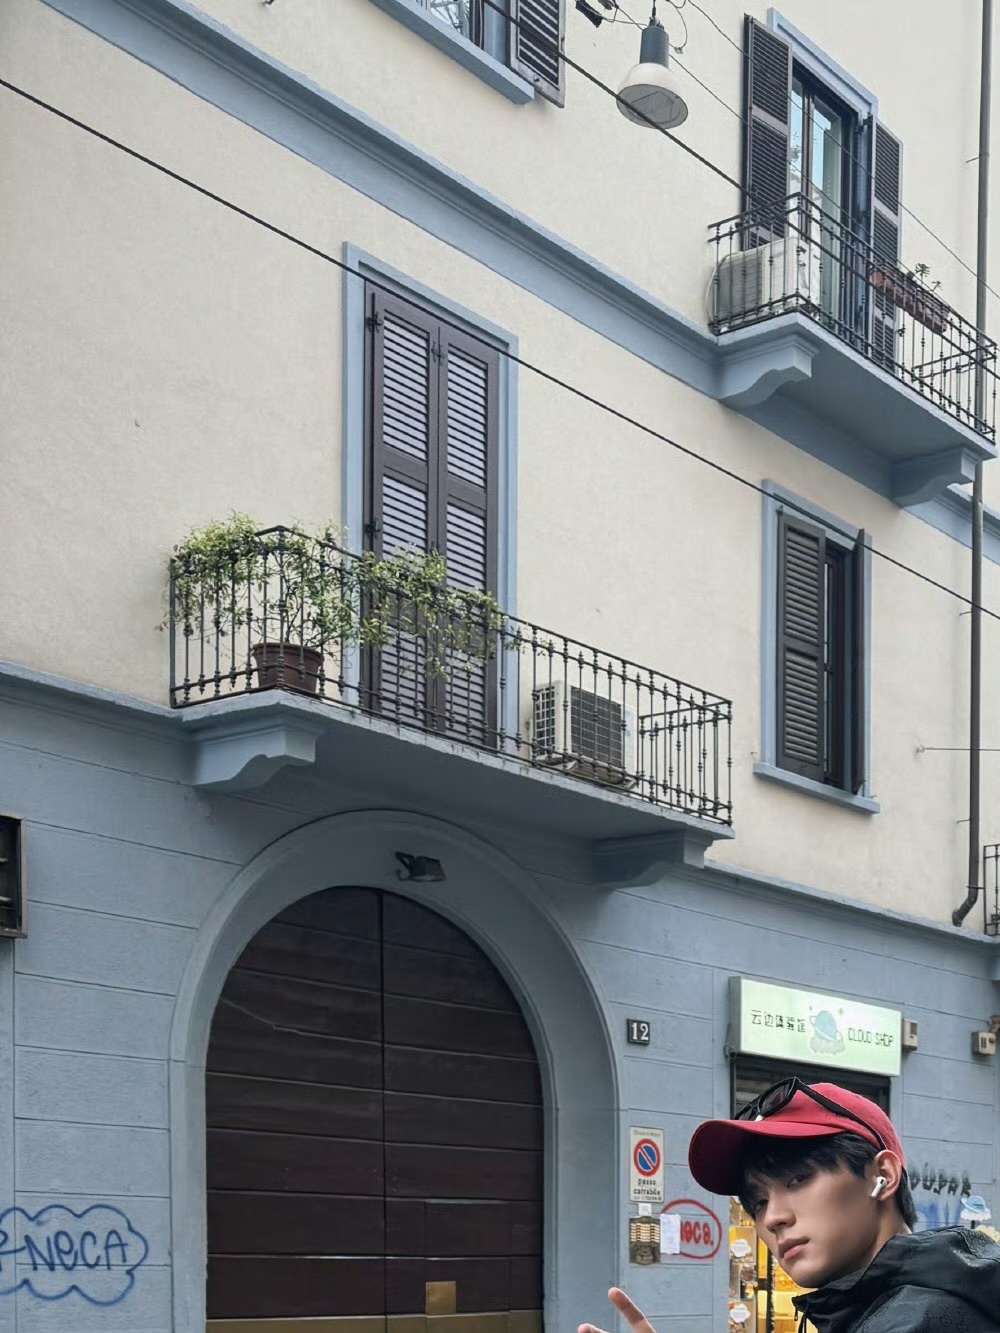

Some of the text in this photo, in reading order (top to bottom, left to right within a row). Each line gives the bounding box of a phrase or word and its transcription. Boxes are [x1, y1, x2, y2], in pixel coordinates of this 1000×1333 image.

[631, 1022, 649, 1040] 12
[848, 1027, 894, 1047] CLOUD SHOP
[637, 1179, 657, 1187] passo
[633, 1187, 661, 1196] carrabile
